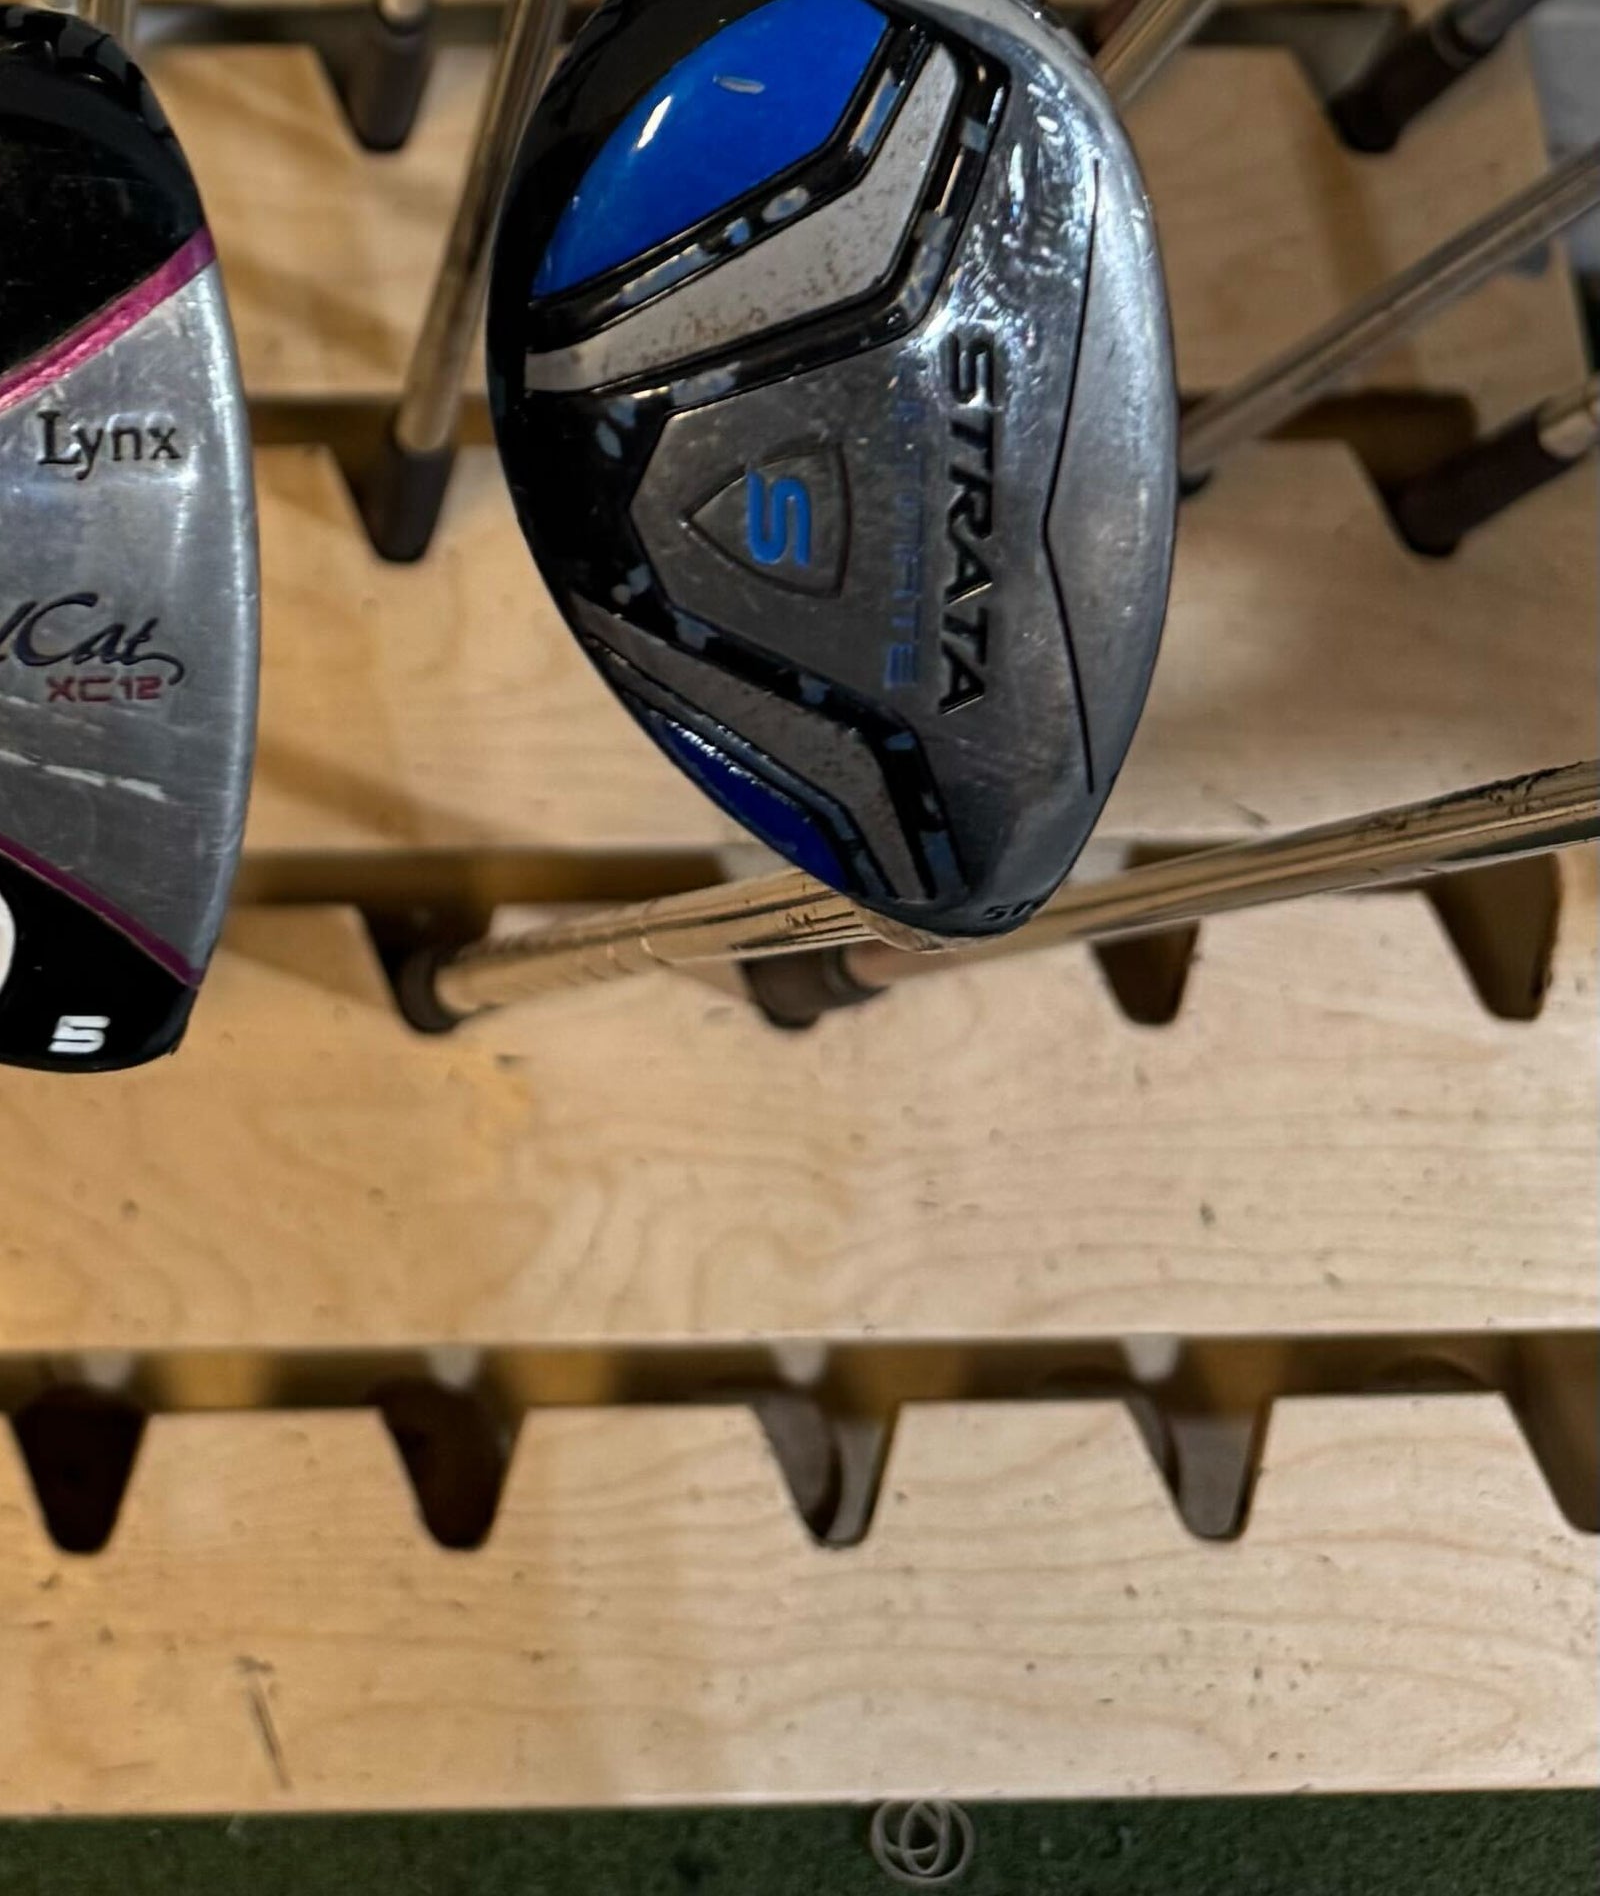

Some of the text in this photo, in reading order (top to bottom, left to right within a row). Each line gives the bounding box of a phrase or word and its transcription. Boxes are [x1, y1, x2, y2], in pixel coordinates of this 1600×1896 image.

[37, 410, 183, 482] Lynx
[938, 327, 996, 717] STRATA
[47, 675, 165, 704] XC12
[46, 1014, 111, 1054] 5
